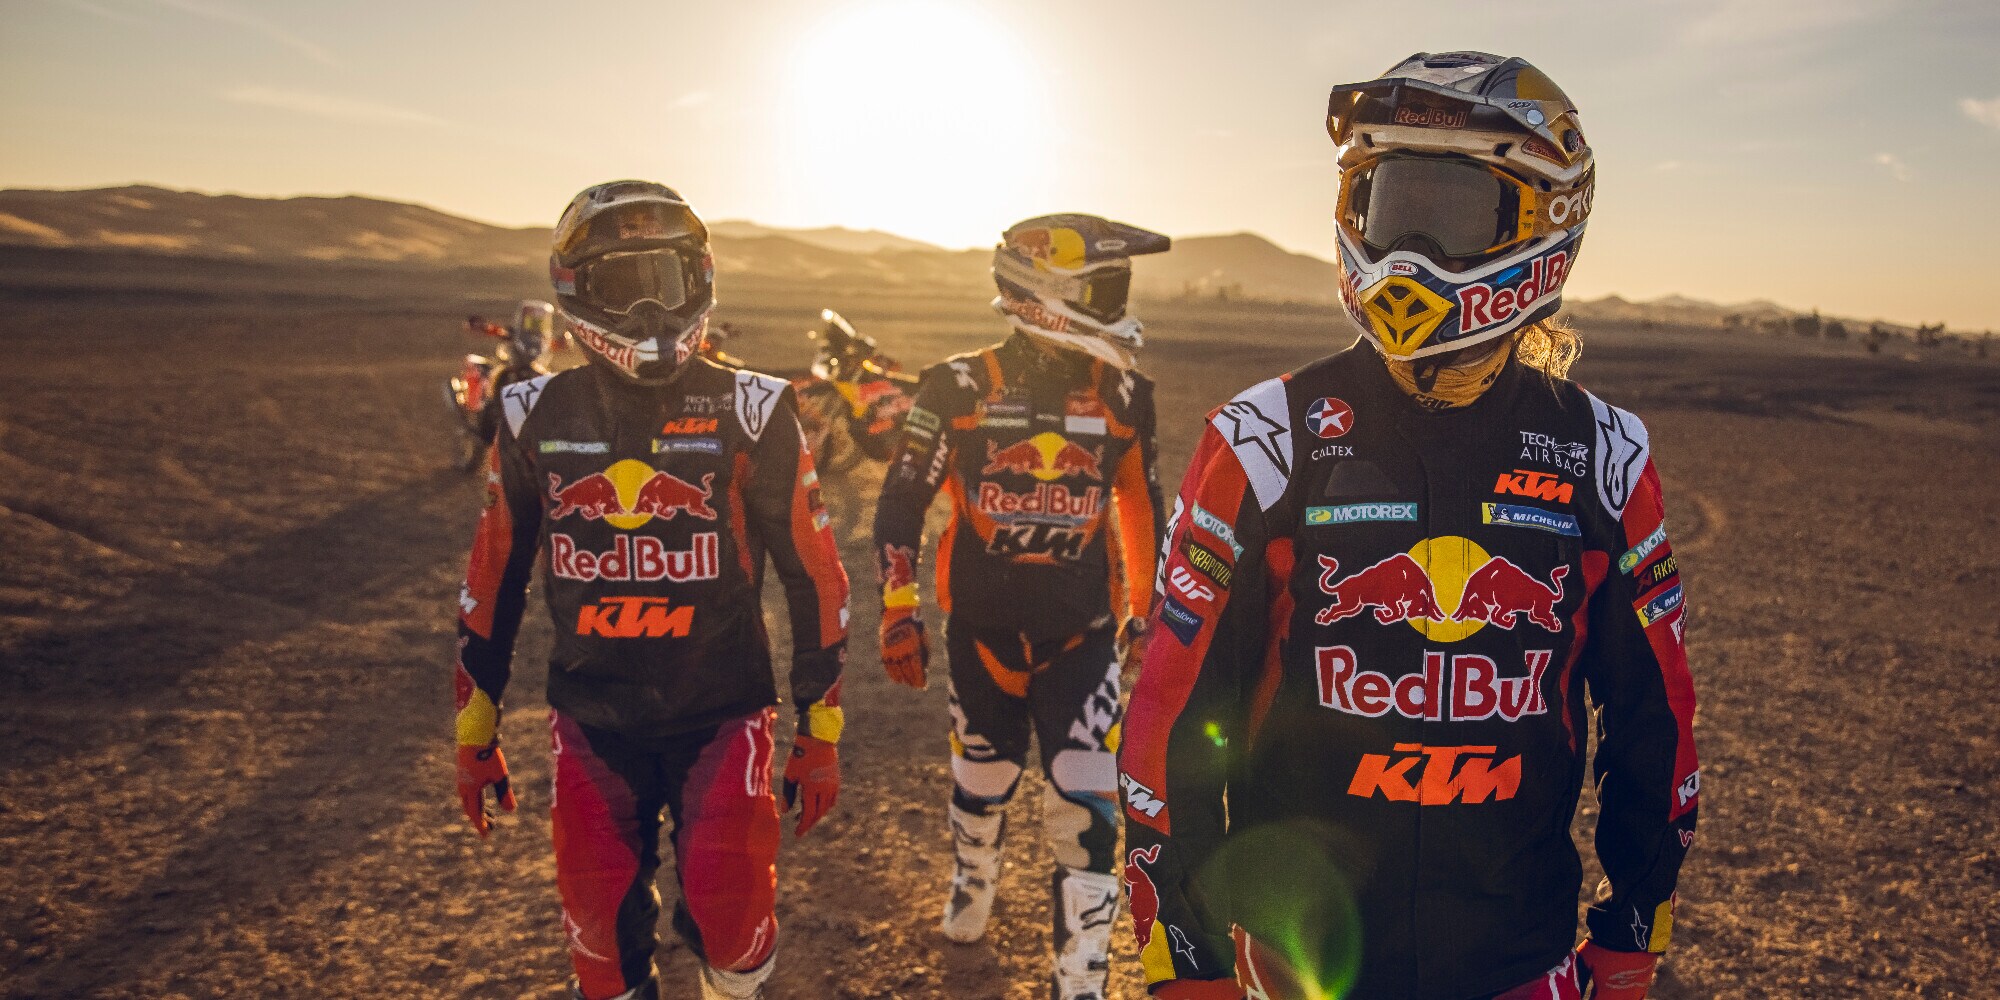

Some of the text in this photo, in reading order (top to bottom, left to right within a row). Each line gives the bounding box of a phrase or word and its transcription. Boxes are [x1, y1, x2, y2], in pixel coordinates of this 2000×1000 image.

[1395, 107, 1467, 129] Red Bull
[1391, 264, 1414, 274] BELL
[1456, 256, 1544, 335] Red
[662, 417, 718, 435] KTM
[1519, 430, 1557, 450] TECH
[1311, 445, 1354, 461] CALTEX
[979, 481, 1102, 517] Red Bull
[1493, 468, 1574, 504] KTM
[1333, 504, 1414, 522] MOTOREX
[1513, 512, 1573, 529] MICHELIN
[549, 531, 719, 583] Red Bull
[984, 518, 1087, 561] KTM
[1170, 565, 1215, 602] WP
[576, 596, 696, 639] KTM
[1314, 644, 1554, 723] Red Bull
[1346, 742, 1522, 806] KTM
